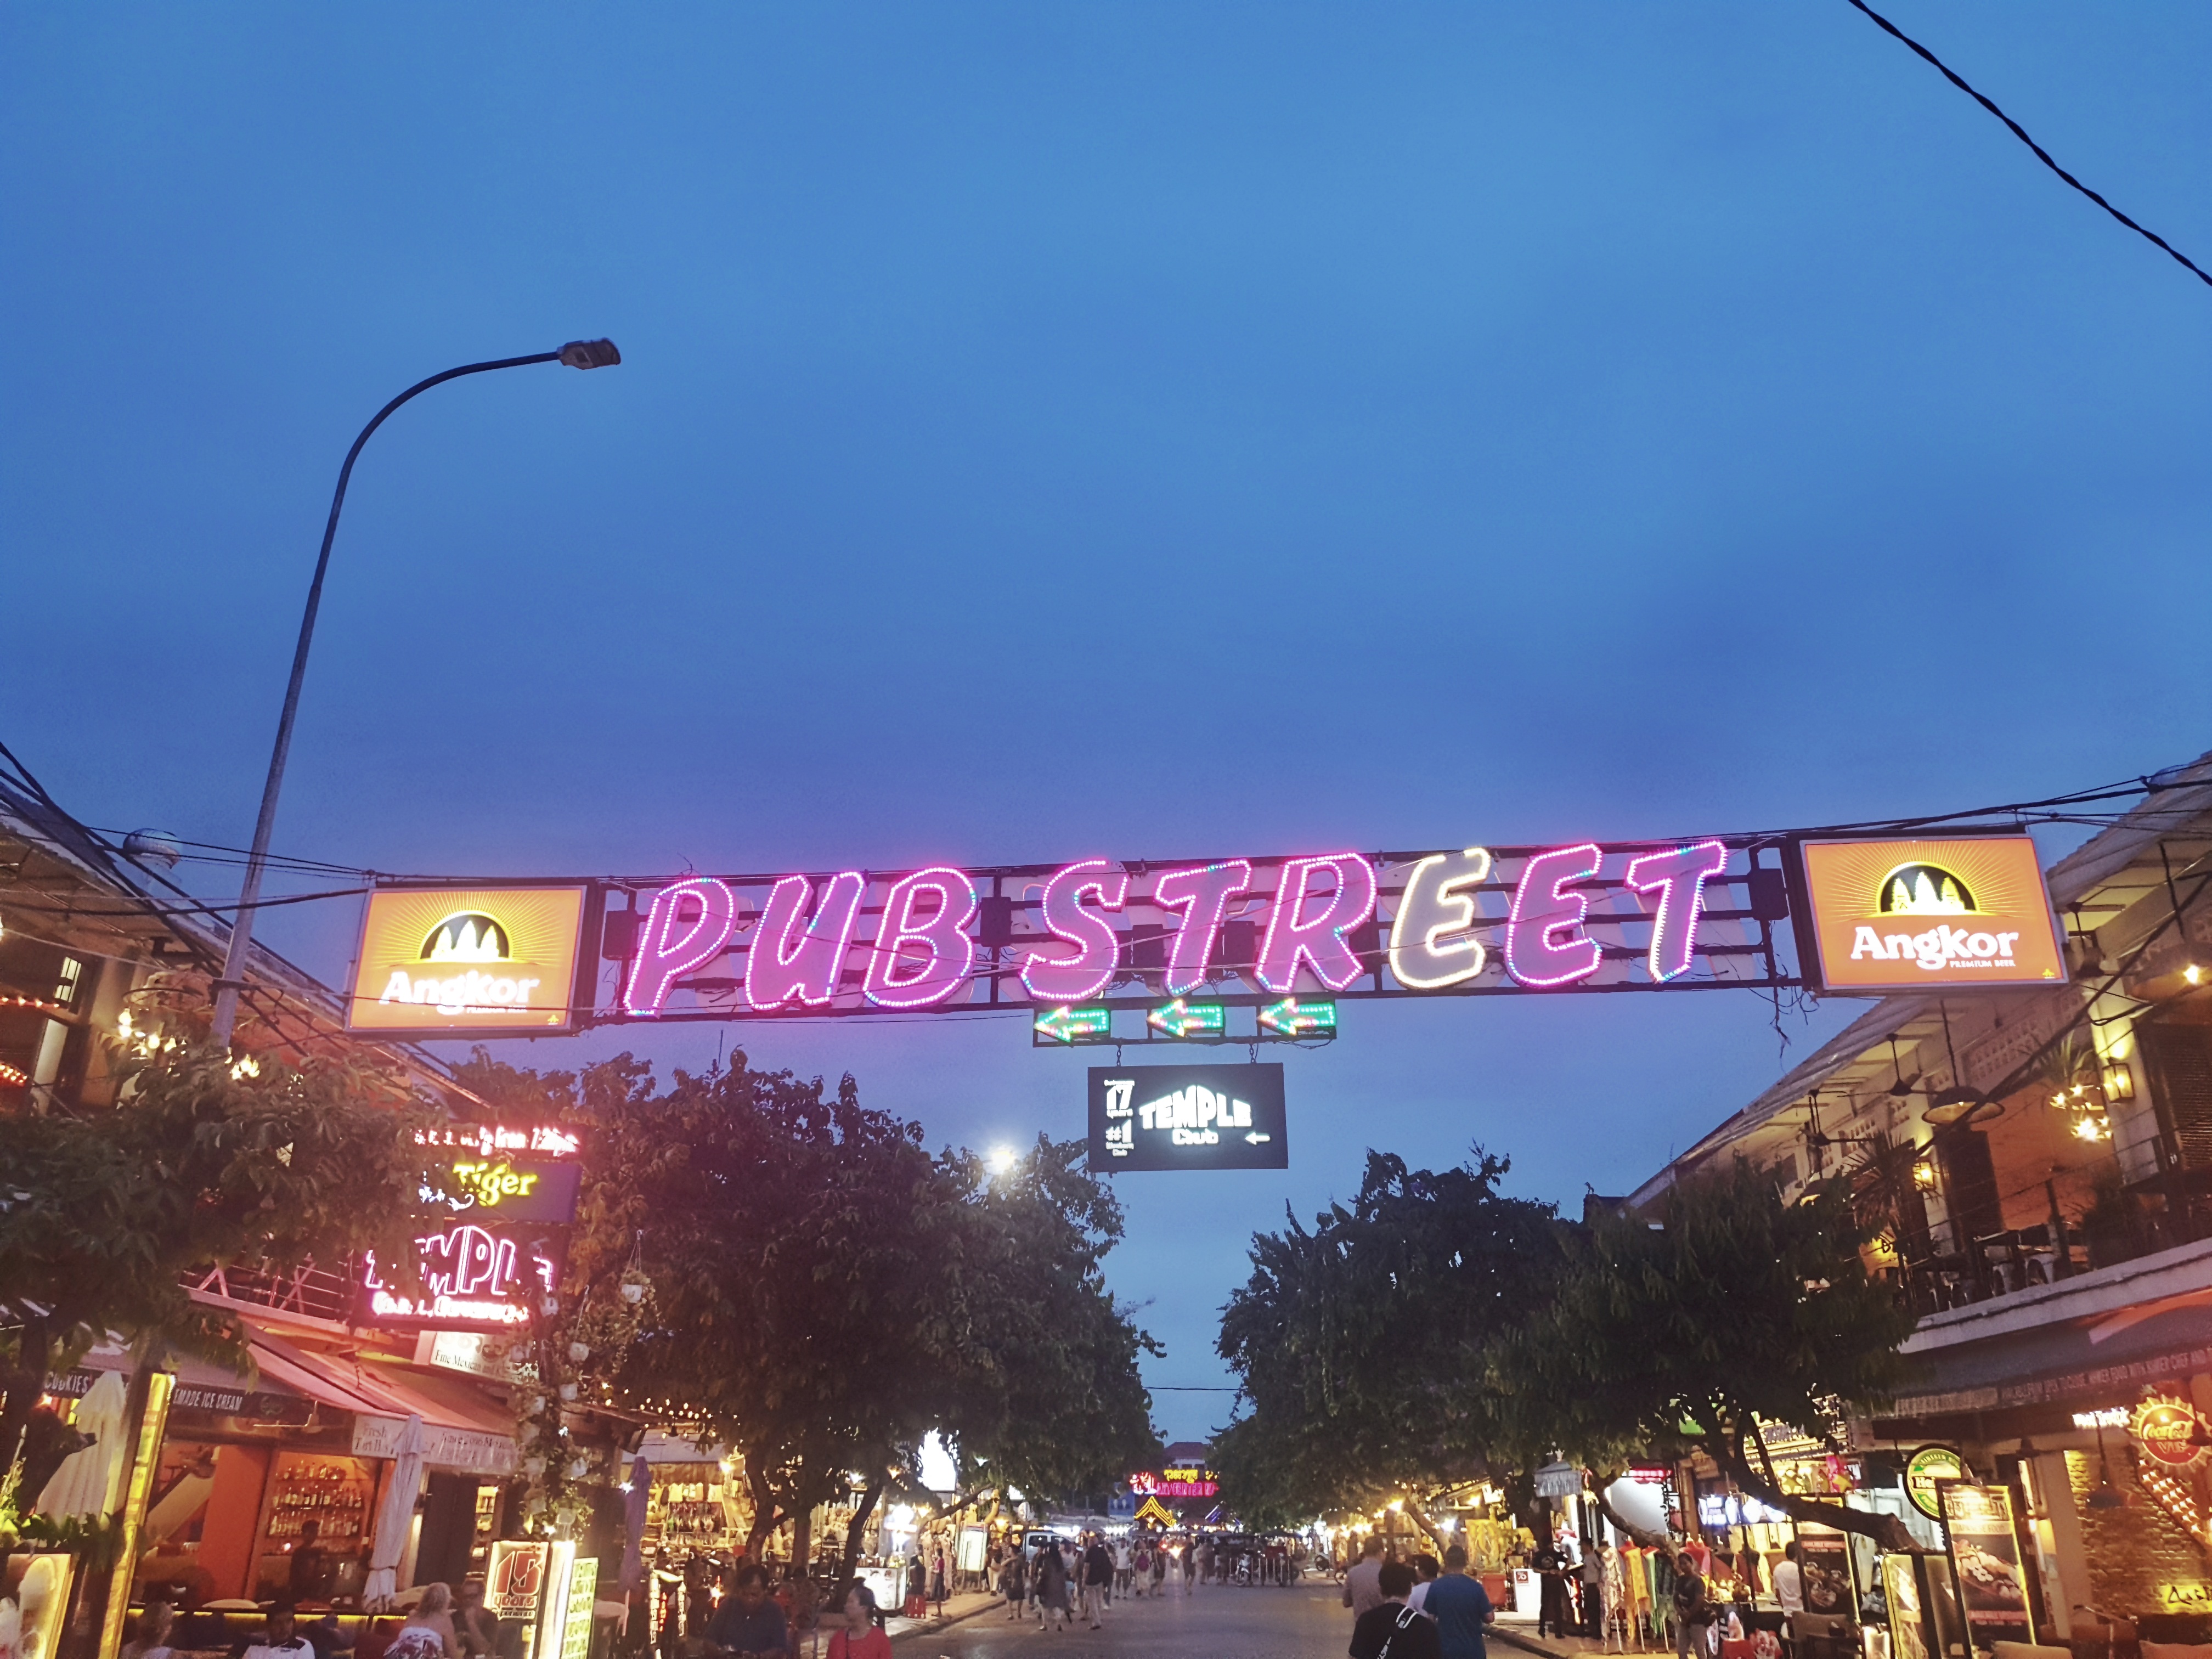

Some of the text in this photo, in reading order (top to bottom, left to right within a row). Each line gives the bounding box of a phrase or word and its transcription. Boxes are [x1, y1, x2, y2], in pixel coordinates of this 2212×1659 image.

[622, 838, 1729, 1019] PUB STREET
[1850, 925, 2019, 969] Angkor
[378, 970, 540, 1015] Angkor
[1107, 1084, 1133, 1110] 17
[1139, 1085, 1252, 1130] TEMPLE
[1105, 1119, 1132, 1143] #1
[1172, 1128, 1218, 1146] Club
[453, 1161, 539, 1207] Tiger
[435, 1349, 452, 1364] Fine
[44, 1371, 90, 1393] COOKIES
[201, 1392, 215, 1408] ICE
[217, 1394, 242, 1412] CREAM
[494, 1550, 545, 1596] 15
